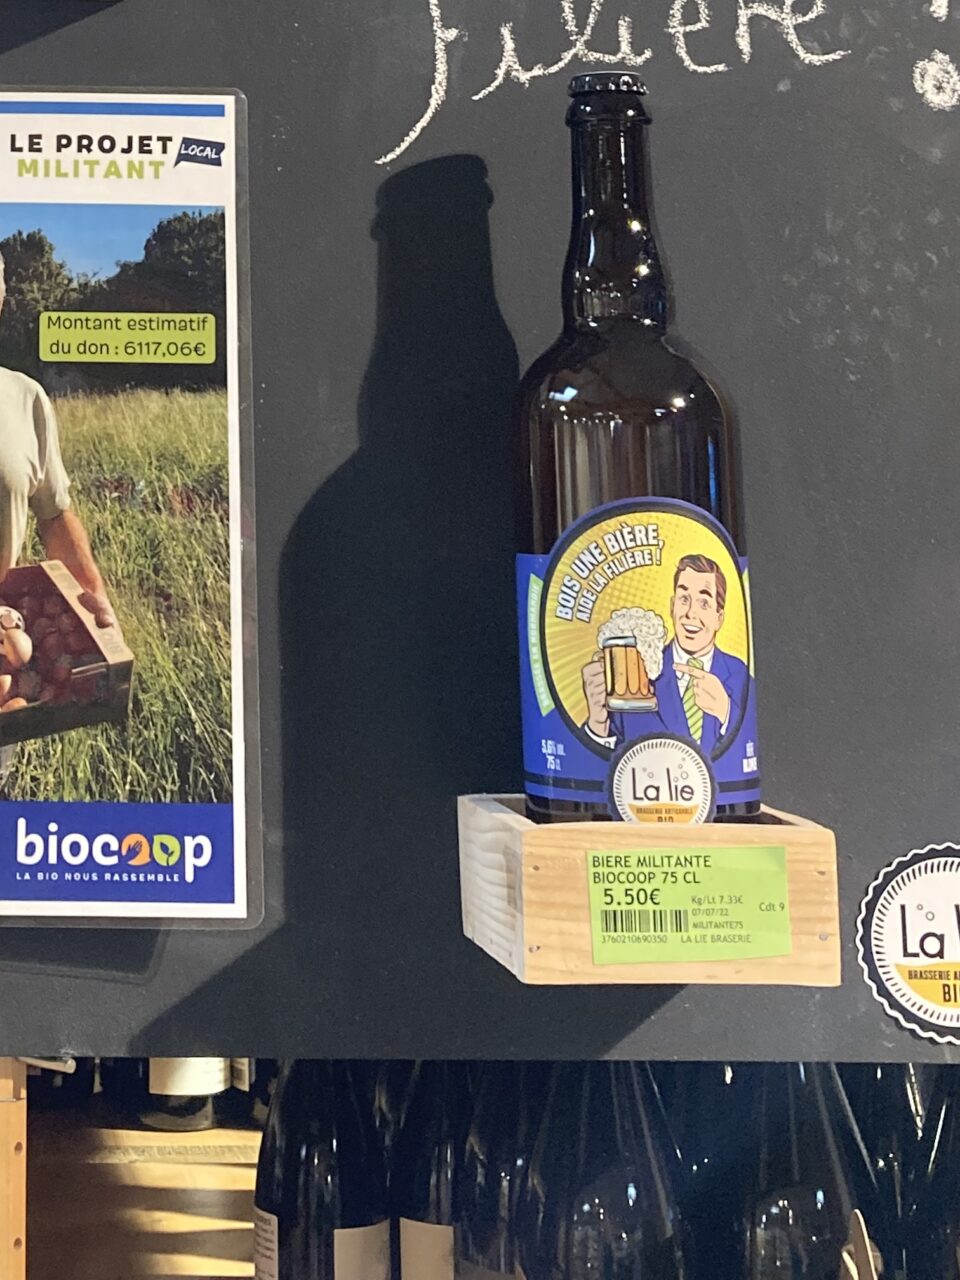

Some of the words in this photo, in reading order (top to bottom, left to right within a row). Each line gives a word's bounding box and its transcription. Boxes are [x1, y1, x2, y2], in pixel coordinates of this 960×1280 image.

[10, 134, 42, 152] LE
[56, 134, 173, 154] PROJET
[180, 144, 219, 159] LOCAL
[17, 159, 166, 179] MILITANT
[47, 316, 122, 331] Montant
[128, 316, 208, 331] estimatif
[50, 340, 71, 354] du
[77, 340, 110, 355] don
[124, 341, 206, 357] 6117,06€
[556, 575, 582, 621] BOIS
[571, 541, 607, 579] UNE
[603, 522, 665, 555] BIÈRE,
[576, 589, 598, 622] AIDE
[588, 572, 609, 593] LA
[603, 549, 653, 580] FILIÈRE
[632, 768, 660, 801] La
[667, 768, 694, 801] lie
[16, 817, 212, 883] biocoop
[592, 855, 631, 868] BIERE
[637, 855, 711, 868] MILITANTE
[16, 872, 31, 880] LA
[37, 872, 58, 881] BIO
[65, 873, 99, 881] NOUS
[104, 873, 180, 882] RASSEMBLE
[593, 872, 656, 884] BIOCOOP
[662, 872, 678, 884] 75
[684, 871, 701, 884] CL
[604, 888, 661, 906] 5.50€
[691, 895, 716, 905] Kg/Lt
[719, 895, 743, 904] 7.33€
[691, 908, 729, 917] 07/07/22
[759, 902, 777, 912] Cdt
[779, 902, 785, 912] 9
[680, 934, 692, 944] LA
[694, 934, 708, 944] LIE
[710, 934, 752, 944] BRASERIE
[900, 904, 945, 960] La
[908, 969, 951, 981] BRASSERIE
[942, 983, 960, 1003] BI
